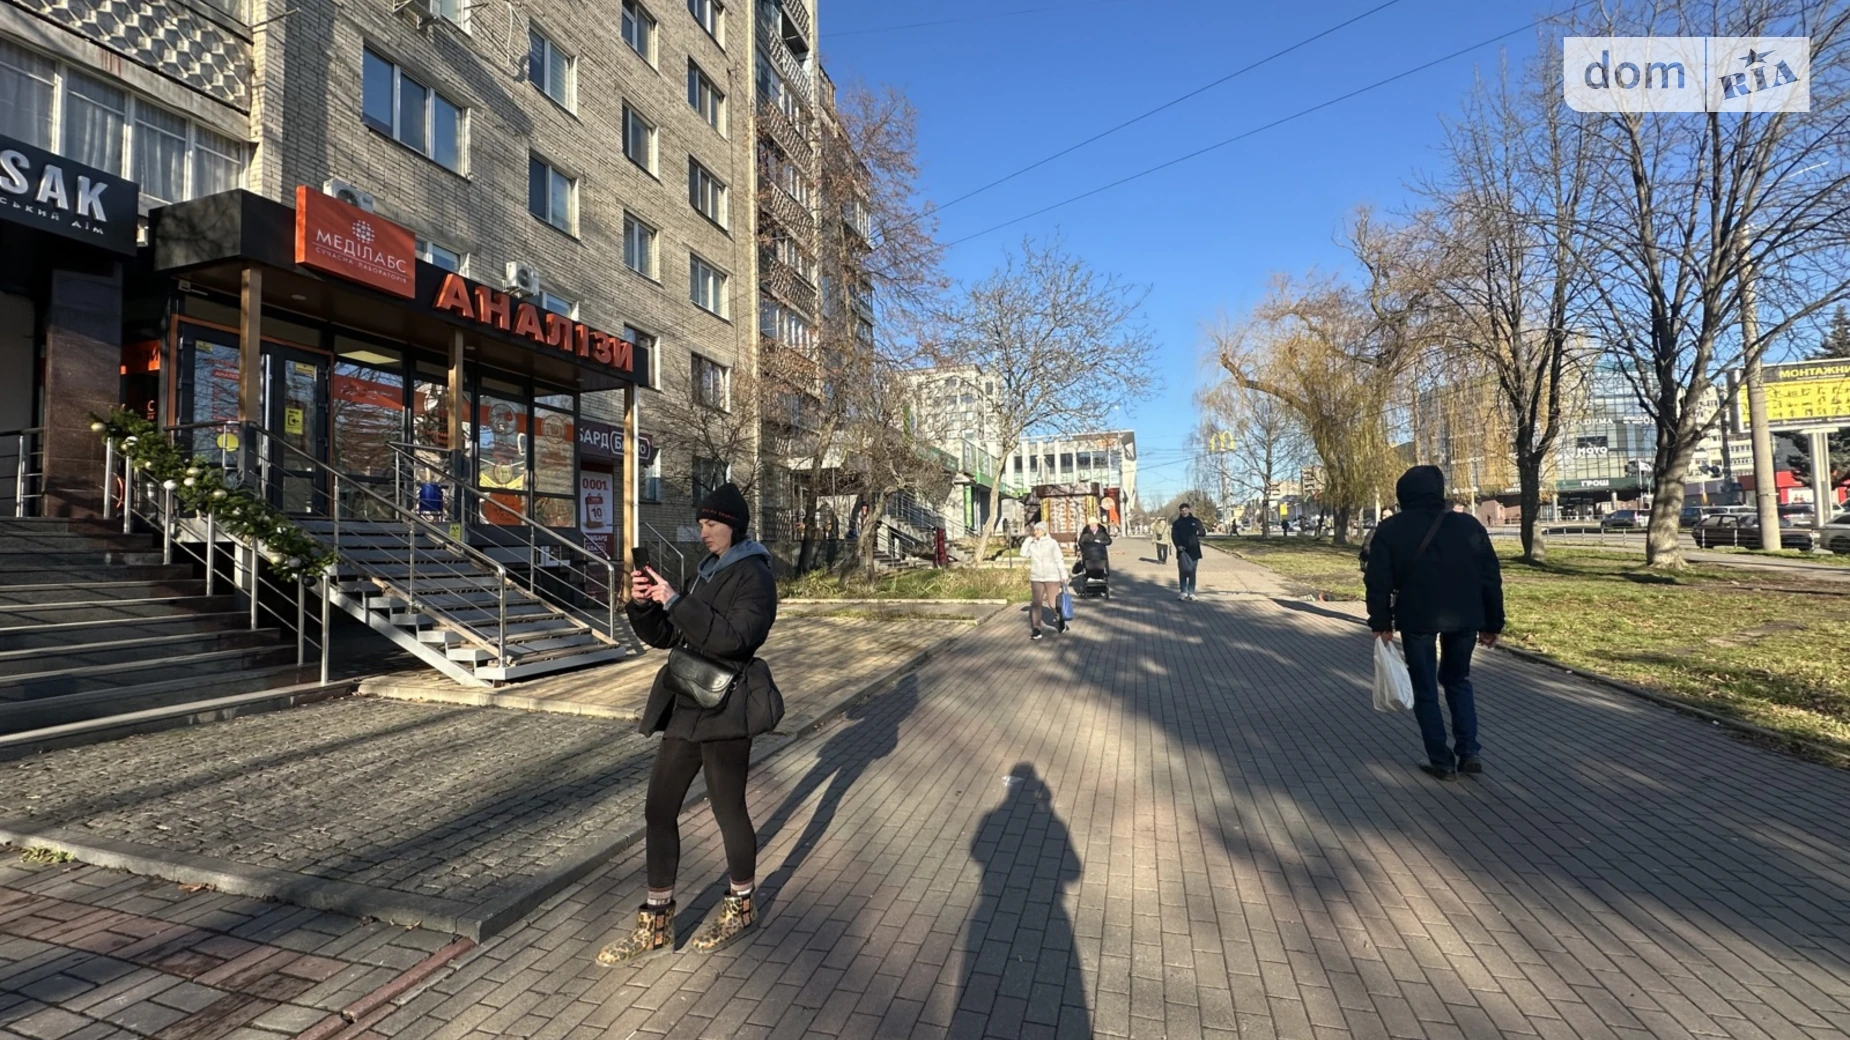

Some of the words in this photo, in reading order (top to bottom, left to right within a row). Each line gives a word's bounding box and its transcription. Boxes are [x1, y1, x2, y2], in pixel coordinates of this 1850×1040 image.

[0, 149, 107, 222] SAK
[315, 228, 407, 274] МЕДІЛАБС
[315, 247, 353, 265] СУЧАСНА
[357, 262, 407, 284] ЛАБОРАТОРІЯ
[433, 273, 634, 373] АНАЛІЗИ
[591, 507, 602, 518] 10
